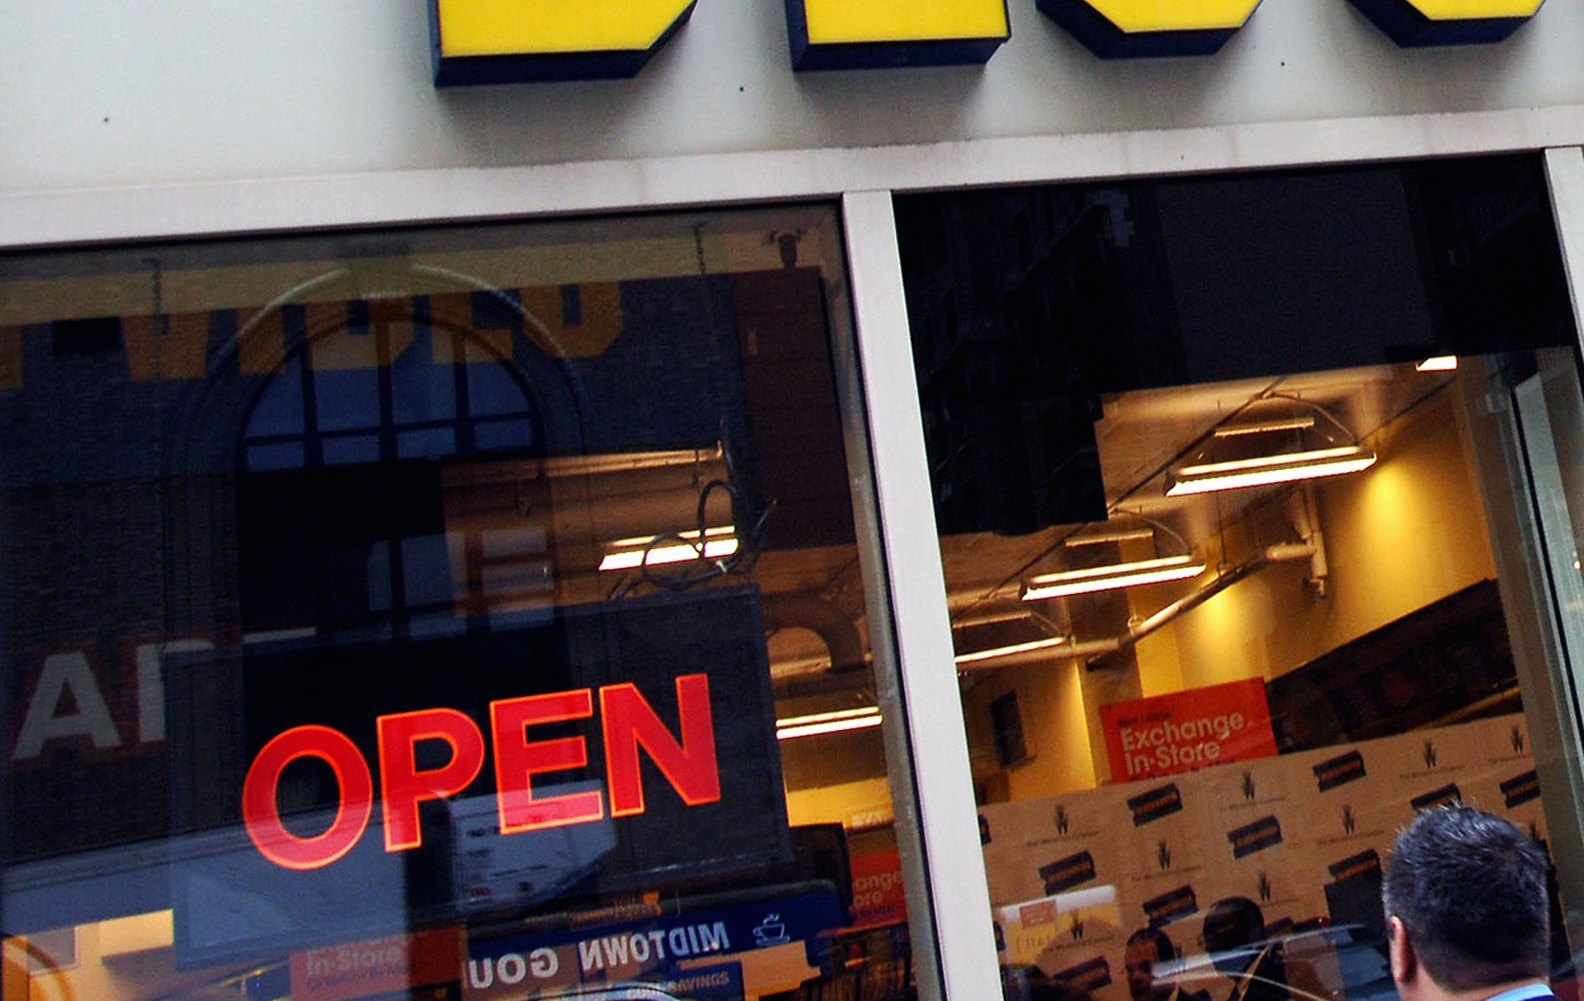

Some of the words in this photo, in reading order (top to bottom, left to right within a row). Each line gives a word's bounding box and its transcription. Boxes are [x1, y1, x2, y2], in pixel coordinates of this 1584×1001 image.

[1119, 711, 1245, 751] Exchange
[241, 672, 723, 870] OPEN
[1124, 741, 1221, 776] In-Store
